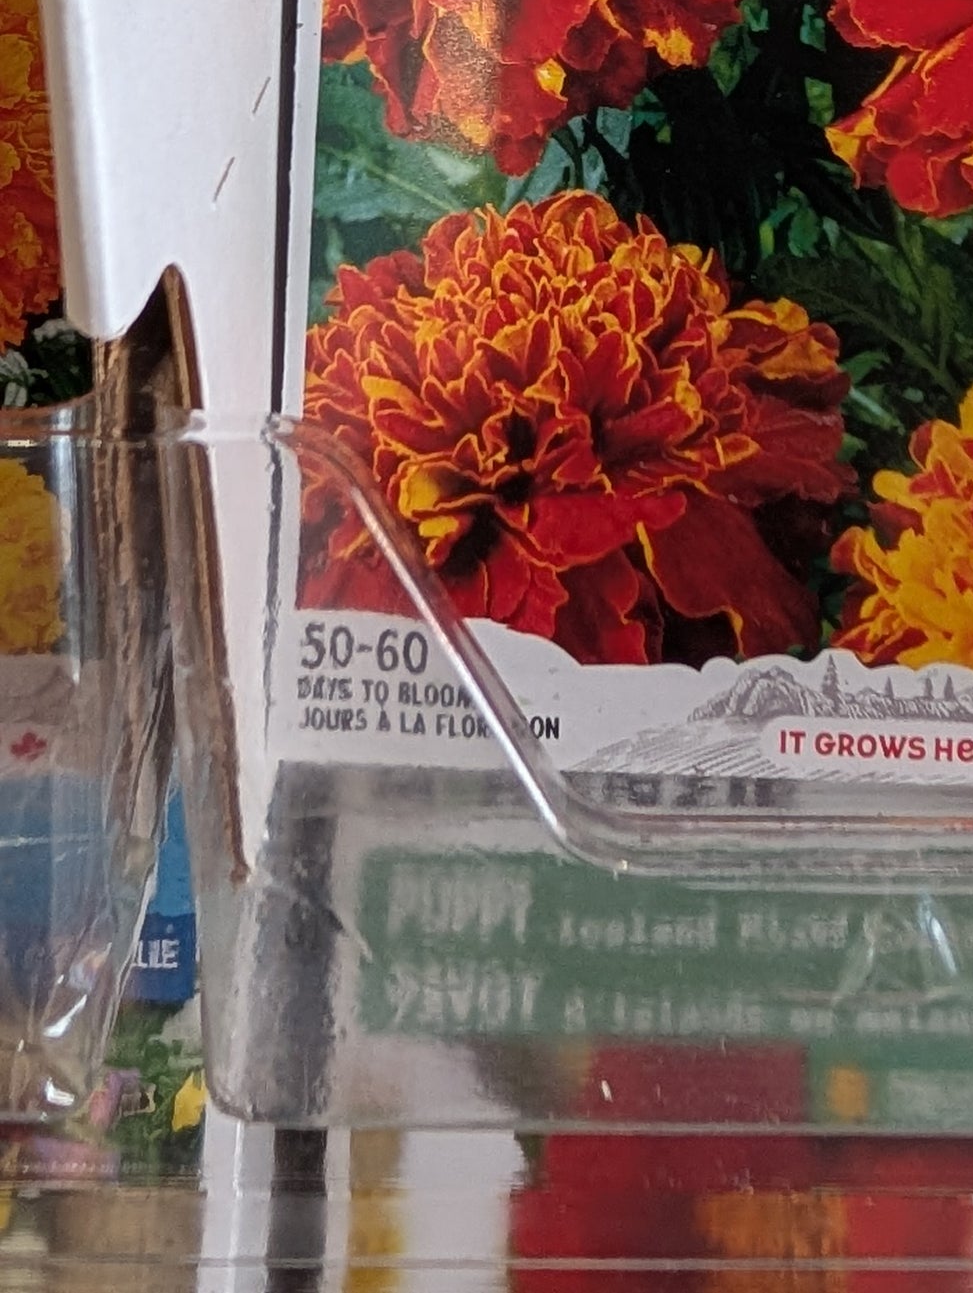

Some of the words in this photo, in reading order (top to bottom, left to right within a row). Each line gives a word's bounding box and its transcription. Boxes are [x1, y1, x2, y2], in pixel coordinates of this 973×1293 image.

[300, 622, 429, 675] 50-60
[297, 676, 353, 700] DAYS
[362, 679, 389, 704] TO
[299, 707, 368, 731] JOURS
[400, 712, 426, 734] LA
[779, 731, 806, 755] IT
[815, 734, 926, 760] GROWS
